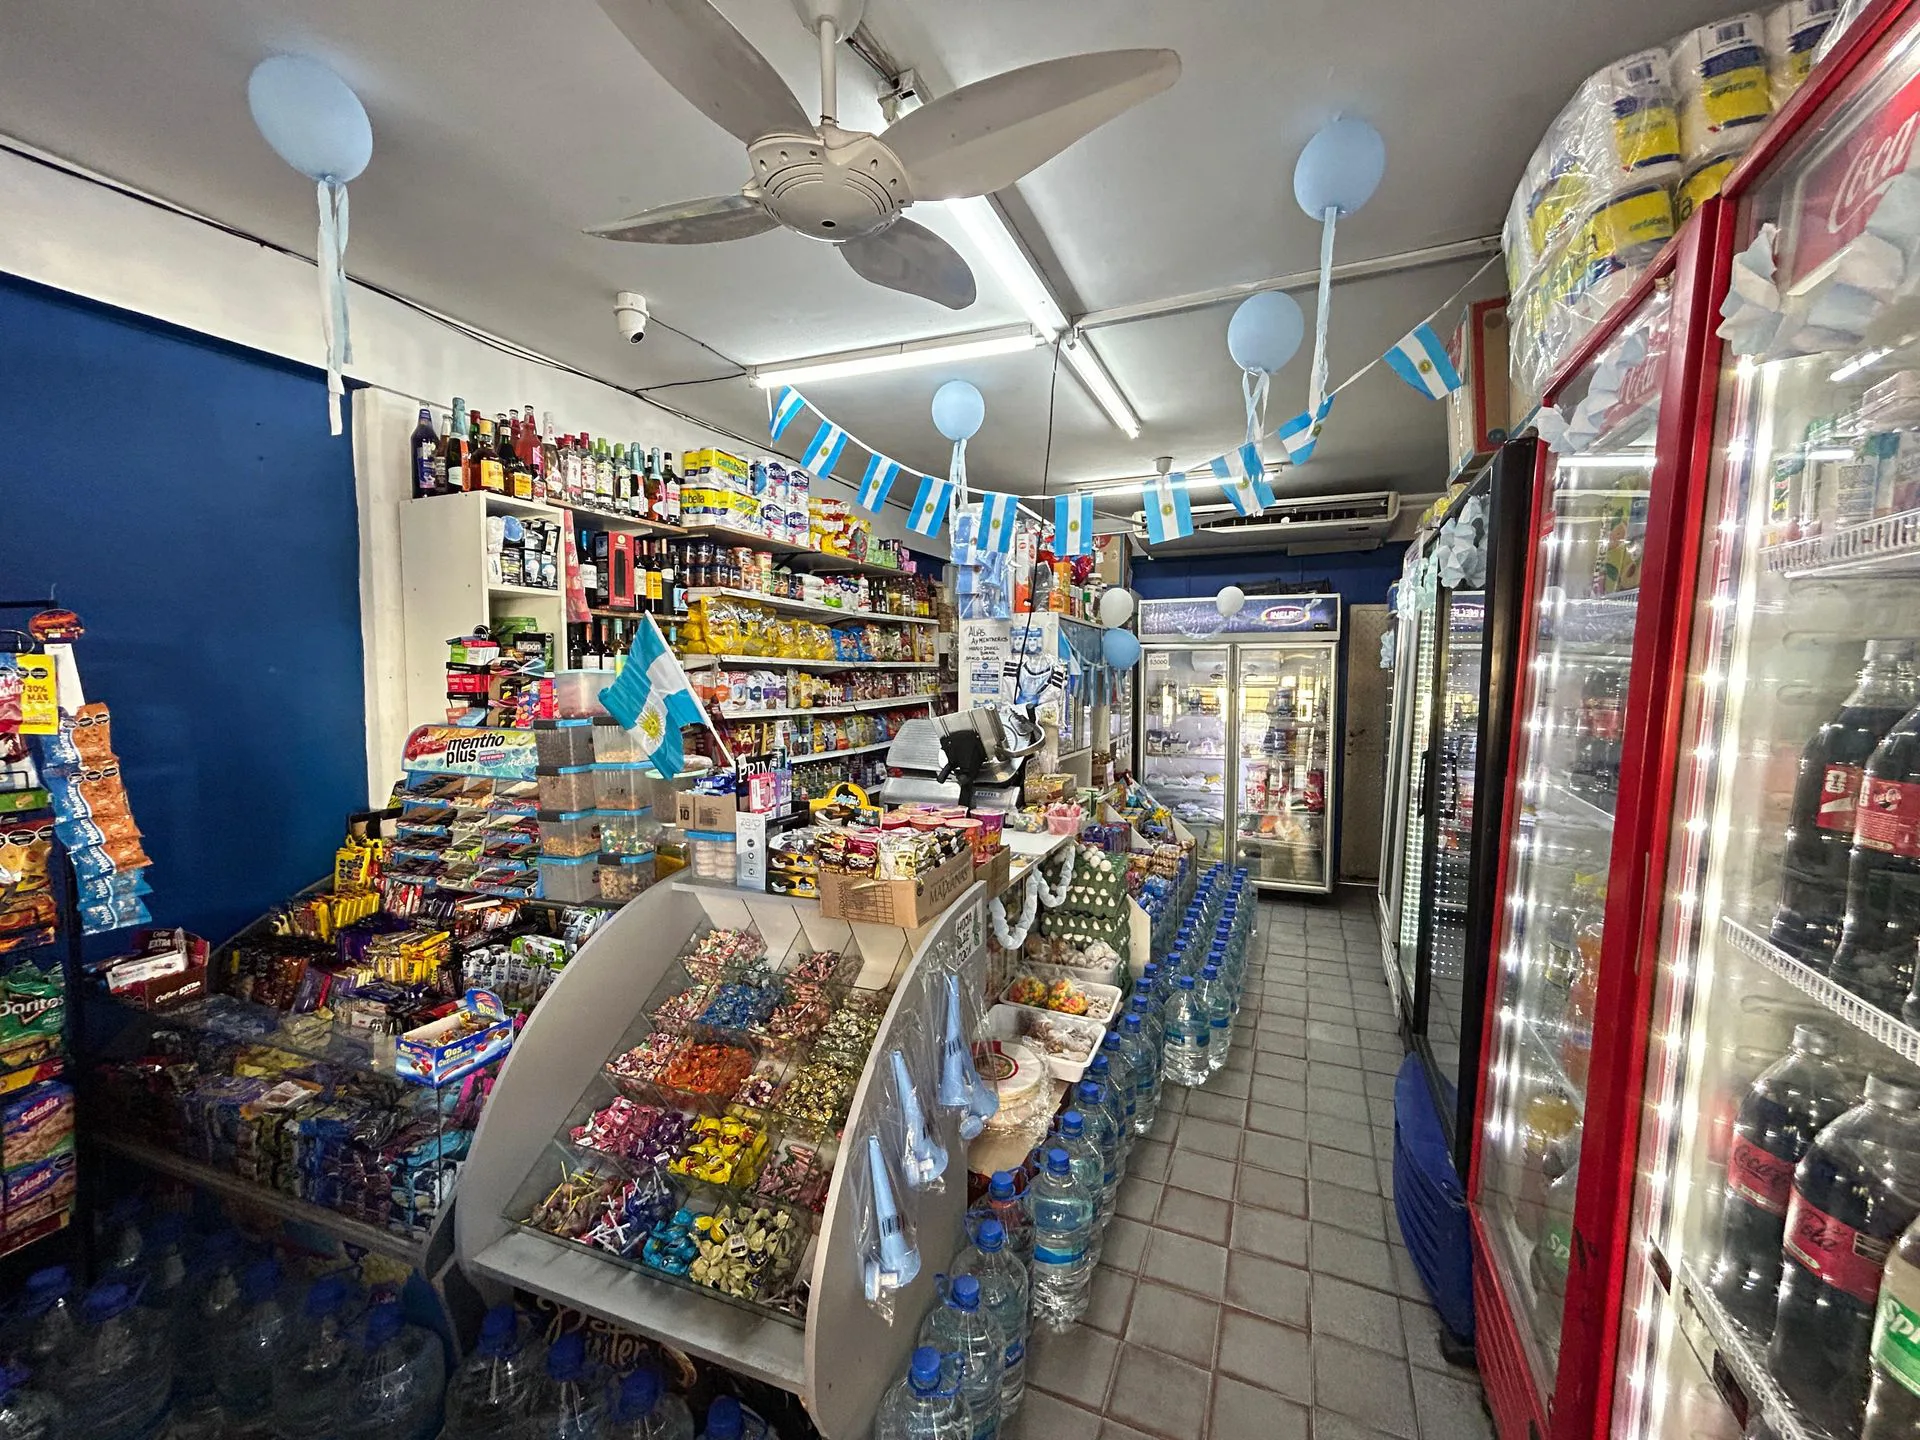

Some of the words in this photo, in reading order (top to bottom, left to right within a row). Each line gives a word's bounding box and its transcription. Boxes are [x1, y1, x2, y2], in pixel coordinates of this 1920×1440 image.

[447, 733, 506, 751] mentho
[446, 747, 477, 768] plus
[738, 760, 777, 783] PRIM
[680, 808, 690, 820] 10
[21, 1097, 59, 1125] Saladix
[10, 1168, 52, 1200] Saladix
